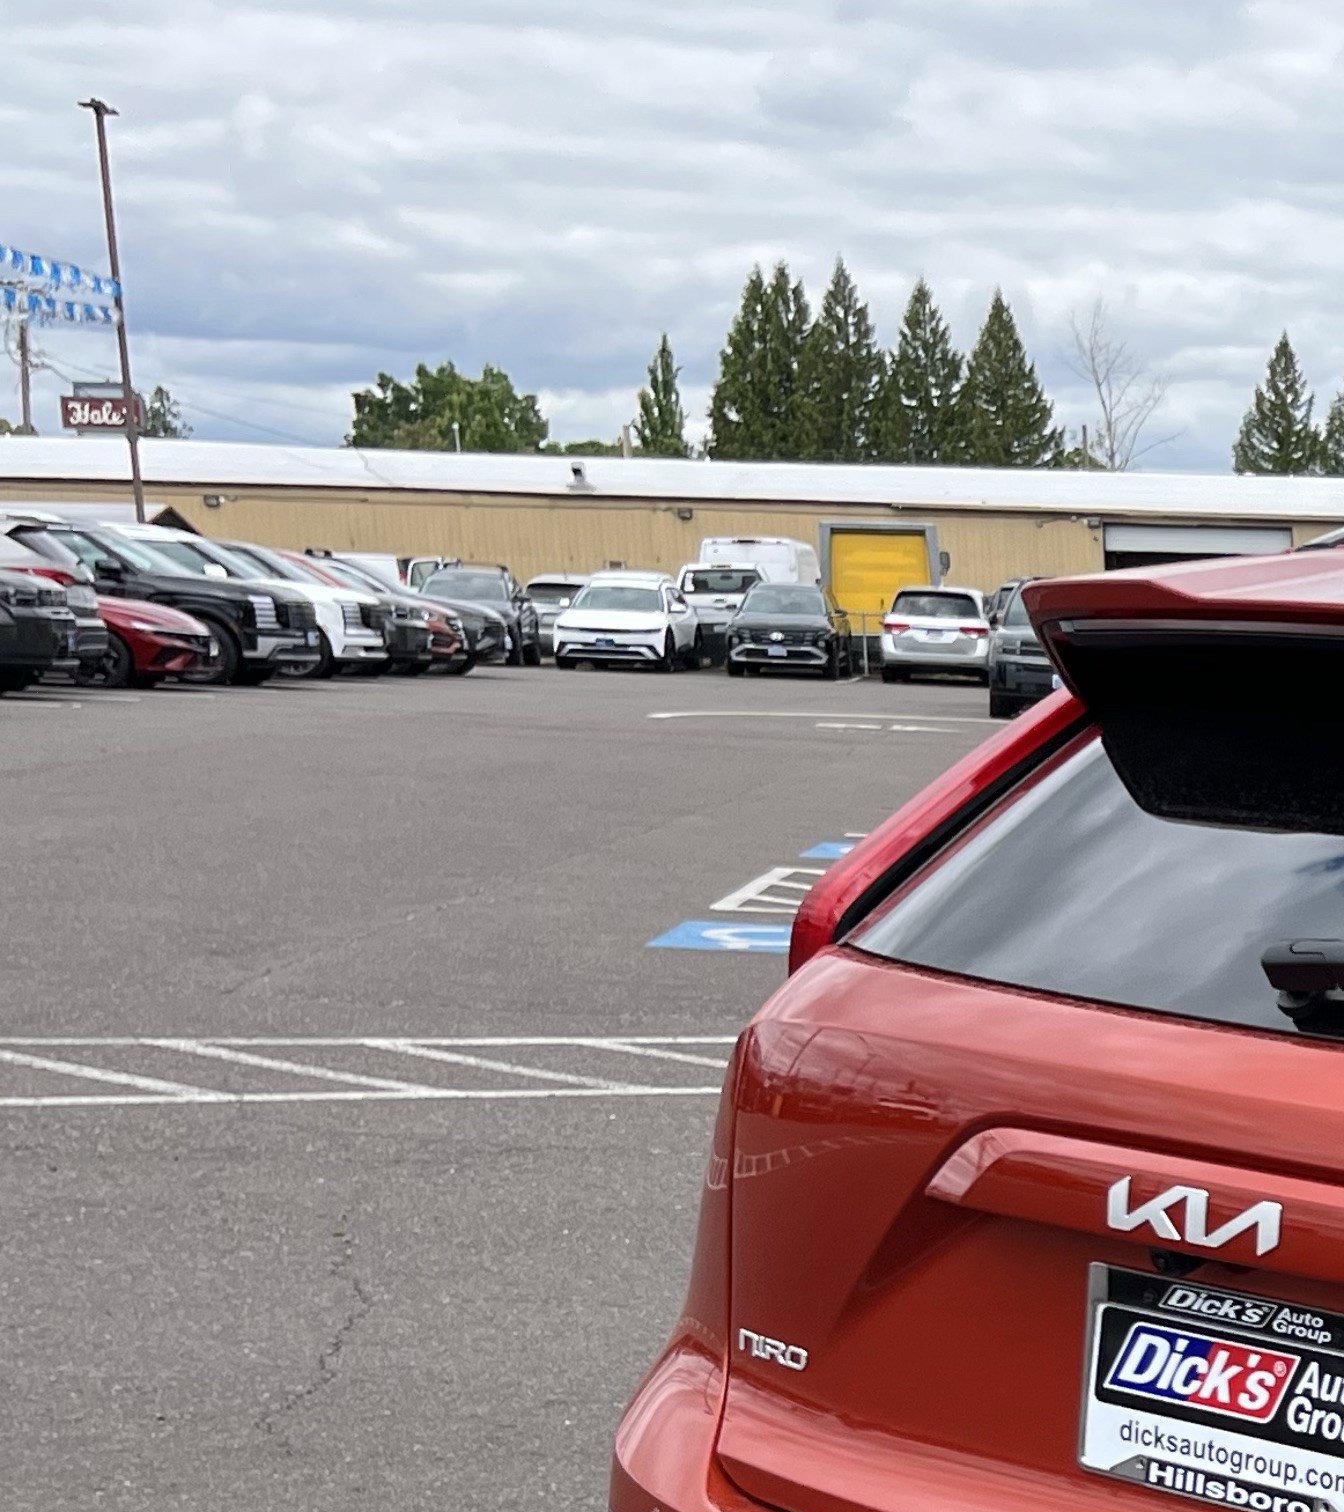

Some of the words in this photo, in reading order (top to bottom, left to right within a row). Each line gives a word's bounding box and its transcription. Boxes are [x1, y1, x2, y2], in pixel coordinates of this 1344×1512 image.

[1107, 1174, 1283, 1256] KIA
[1166, 1287, 1270, 1324] Dick's
[1277, 1307, 1325, 1328] Auto
[1271, 1318, 1333, 1345] Group
[1116, 1331, 1277, 1412] Dick's
